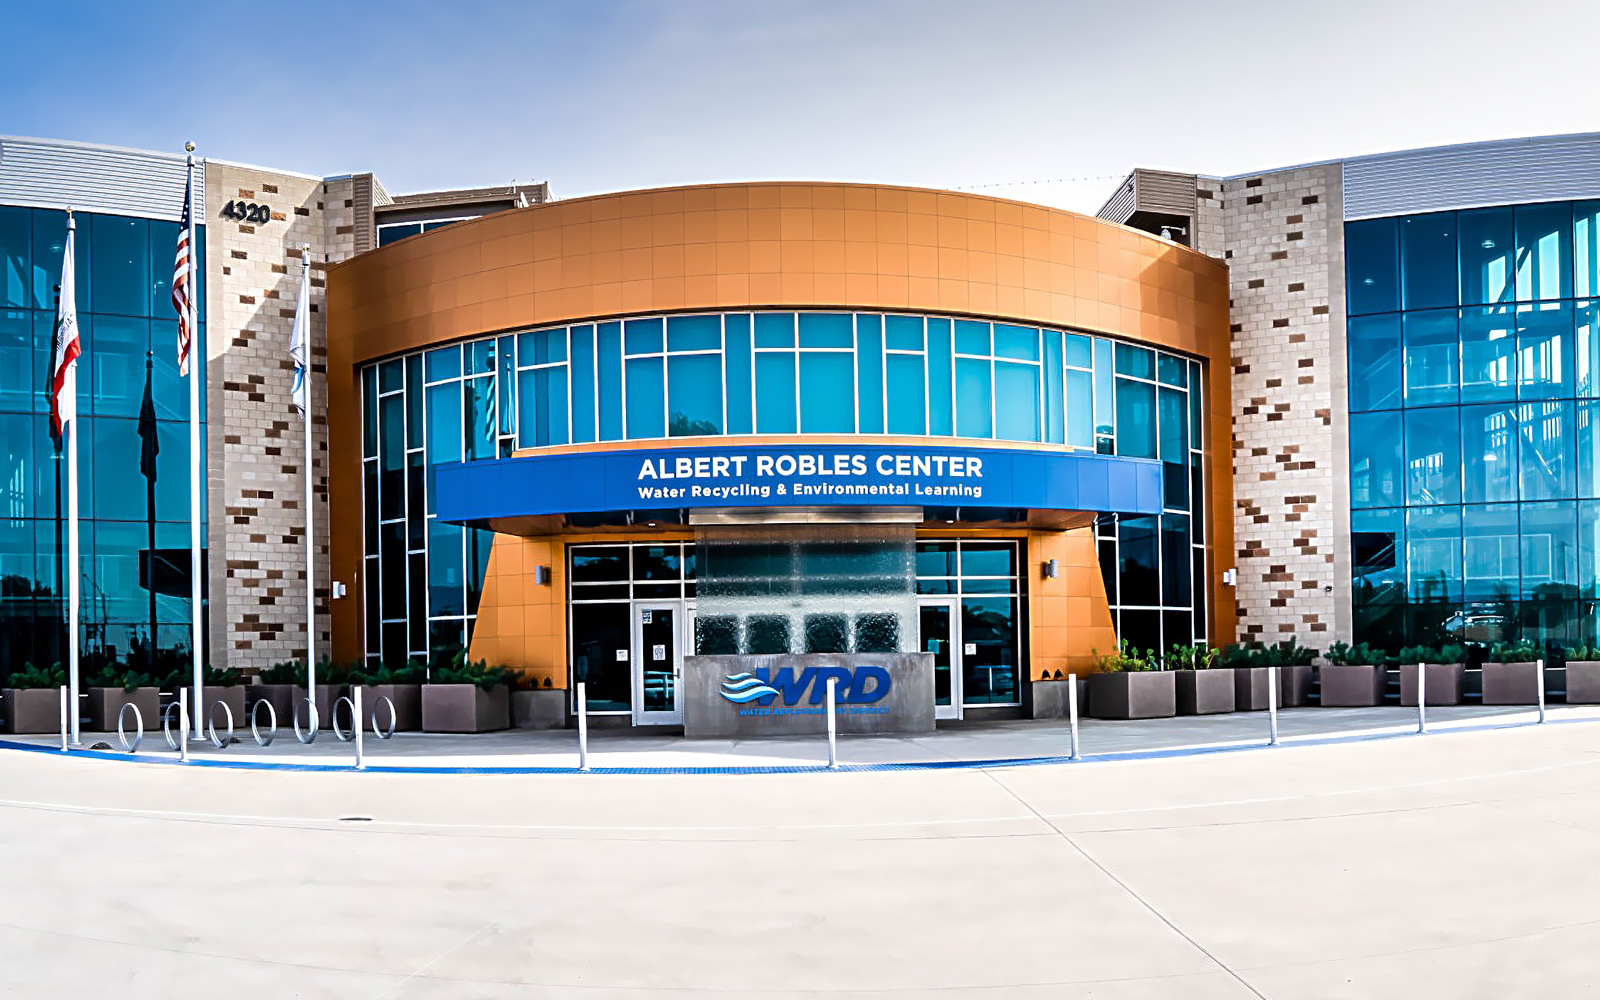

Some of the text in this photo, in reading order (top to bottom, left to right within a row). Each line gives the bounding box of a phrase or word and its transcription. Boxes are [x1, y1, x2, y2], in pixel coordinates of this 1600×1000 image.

[223, 200, 271, 223] 4320
[637, 455, 983, 480] ALBERT ROBLES CENTER
[637, 483, 982, 499] Water Recycling & Environmental Learning
[755, 665, 892, 706] WRD
